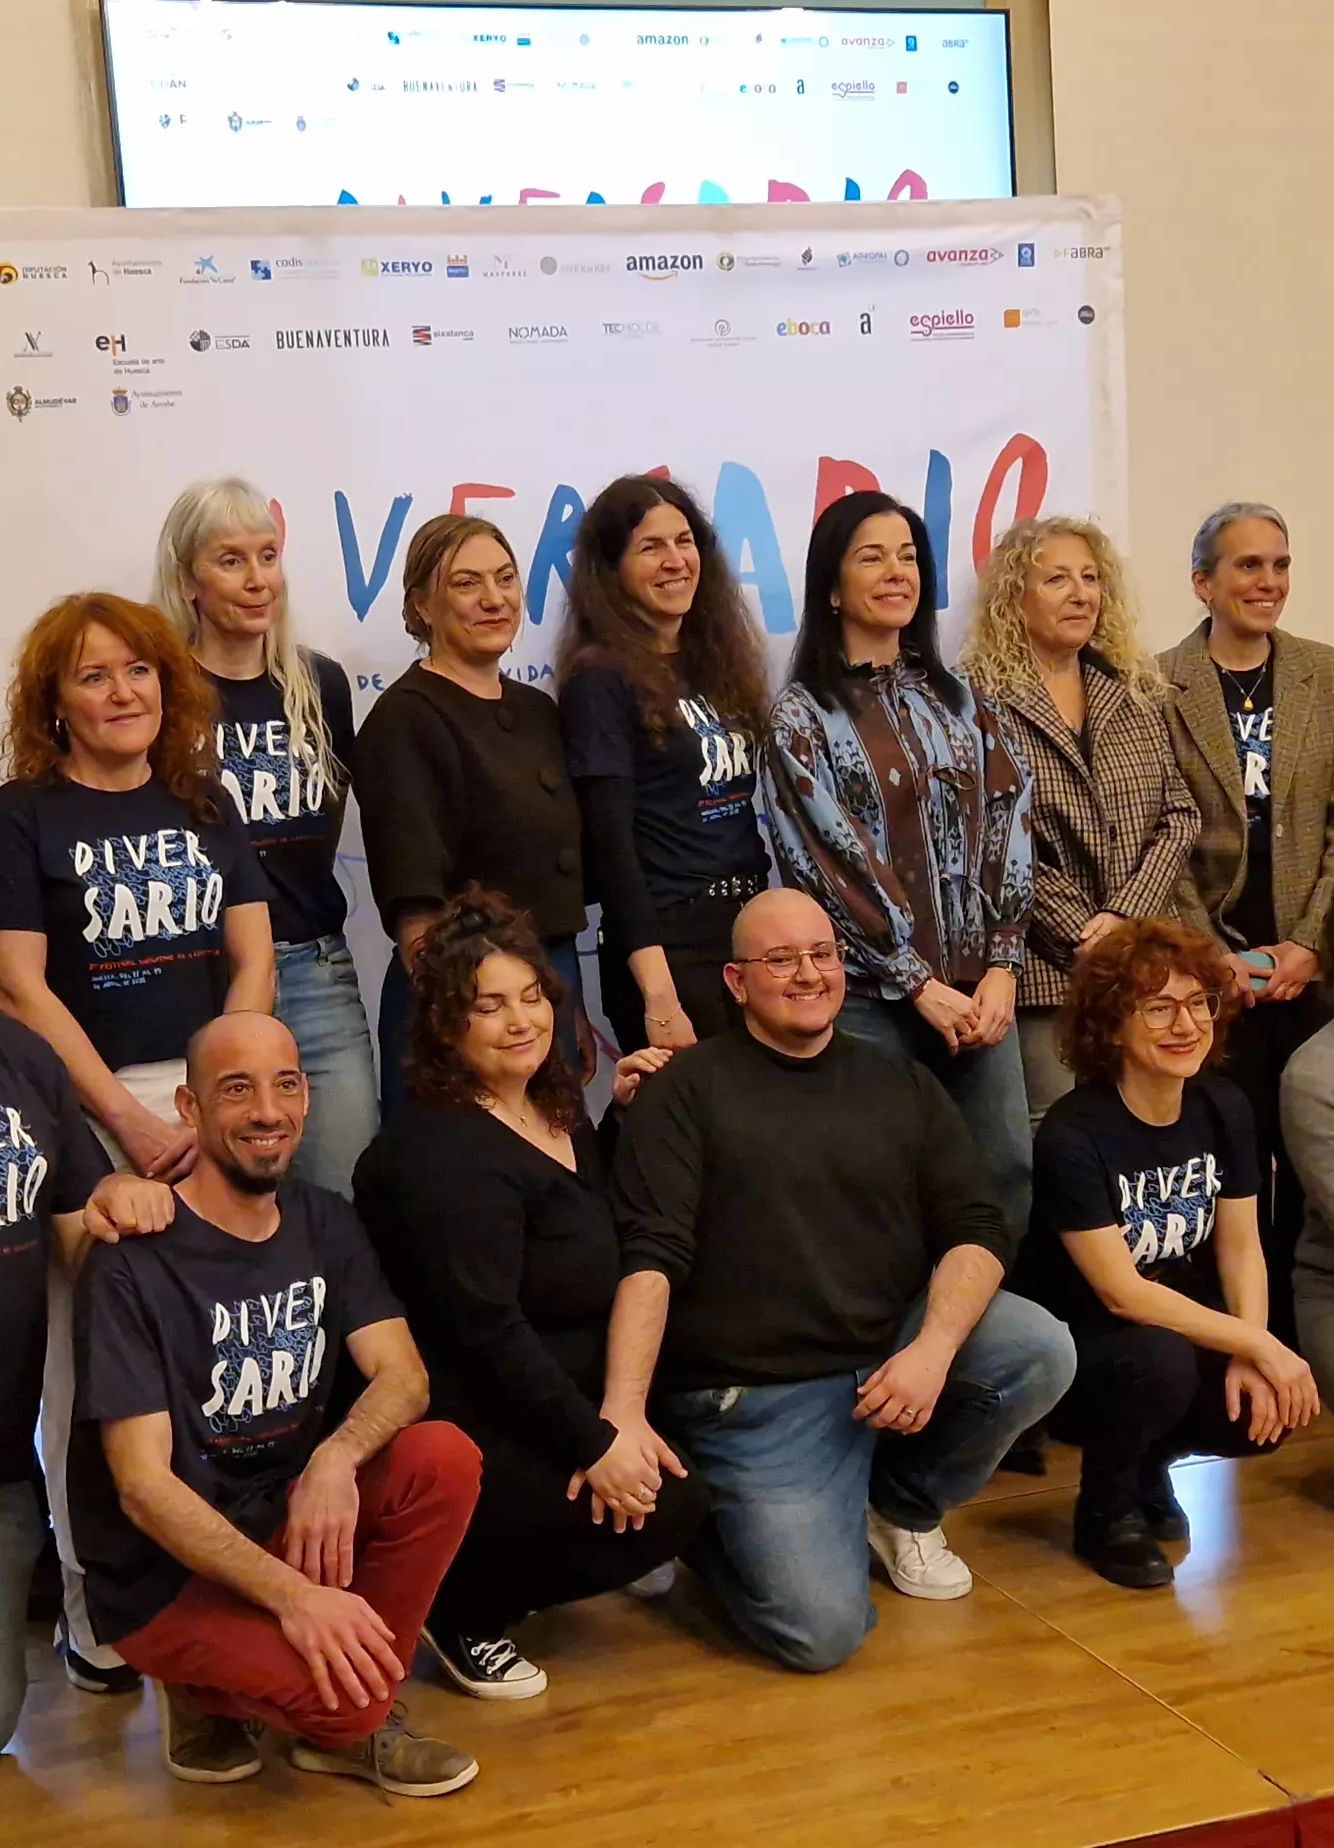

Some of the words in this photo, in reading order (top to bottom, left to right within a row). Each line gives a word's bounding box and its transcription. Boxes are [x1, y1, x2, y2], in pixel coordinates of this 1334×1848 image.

[637, 34, 689, 46] amazon
[626, 254, 704, 272] amazon
[926, 248, 989, 263] avanza
[381, 261, 433, 273] XERYO
[909, 309, 975, 337] espiello
[215, 338, 251, 349] ESDA
[275, 328, 391, 350] BUENAVENTURA
[357, 673, 385, 691] DE
[74, 829, 211, 876] DIVER
[82, 873, 223, 943] SARIO
[1118, 1153, 1222, 1212] DIVER
